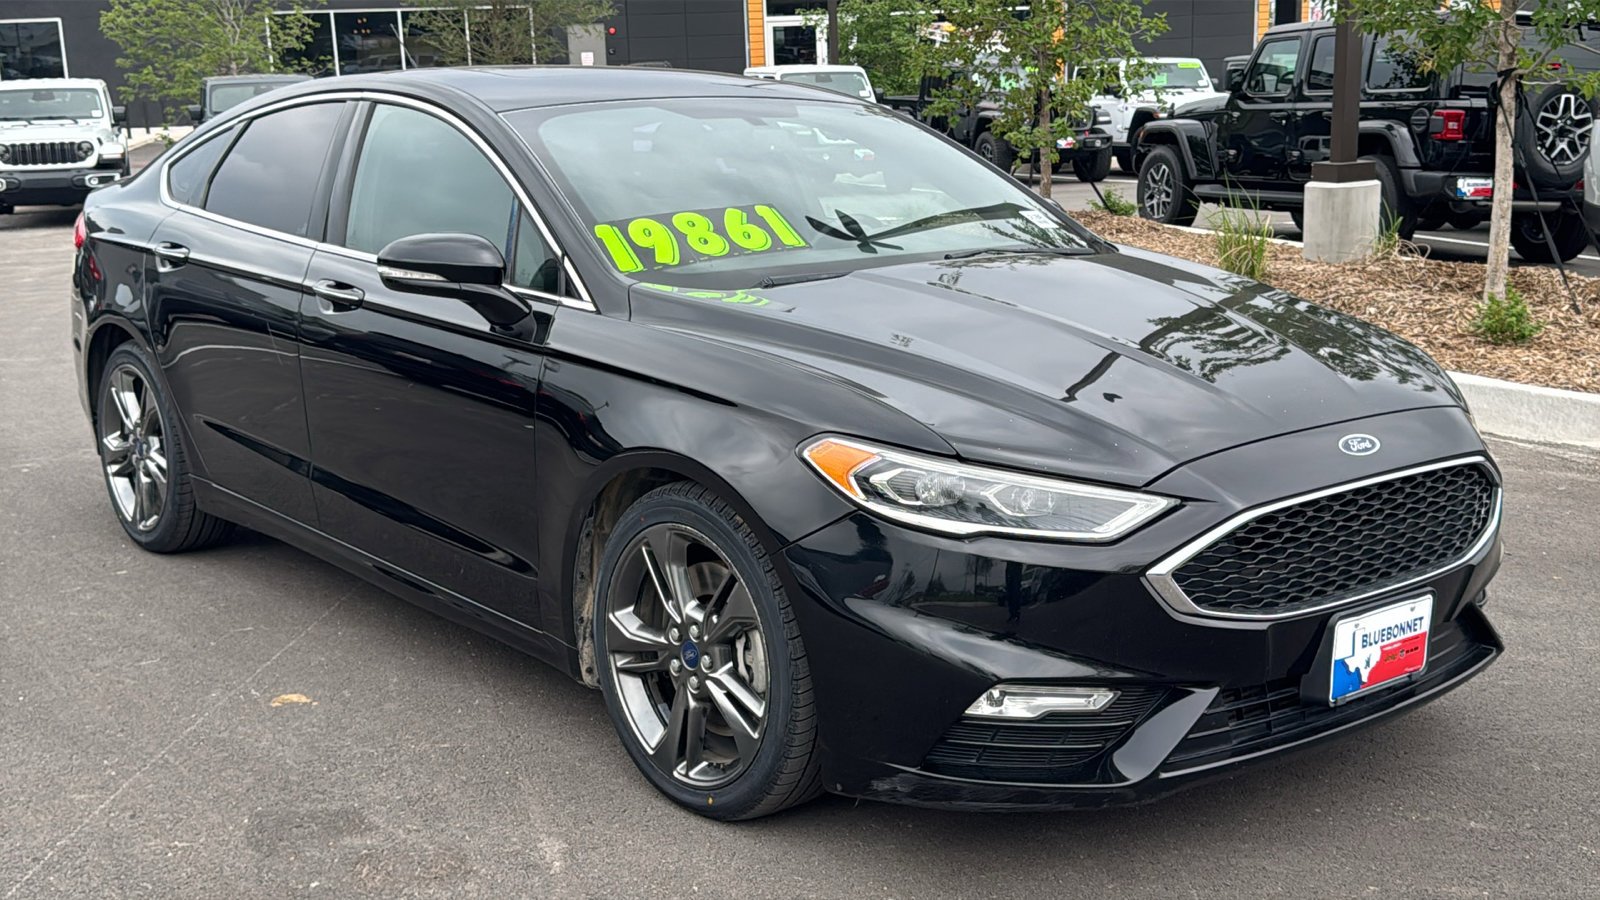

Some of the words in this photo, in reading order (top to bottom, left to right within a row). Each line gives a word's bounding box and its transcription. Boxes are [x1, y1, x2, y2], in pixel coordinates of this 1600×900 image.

[594, 205, 806, 272] 19861
[1347, 438, 1373, 451] Ford
[1361, 616, 1424, 649] BLUEBONNET
